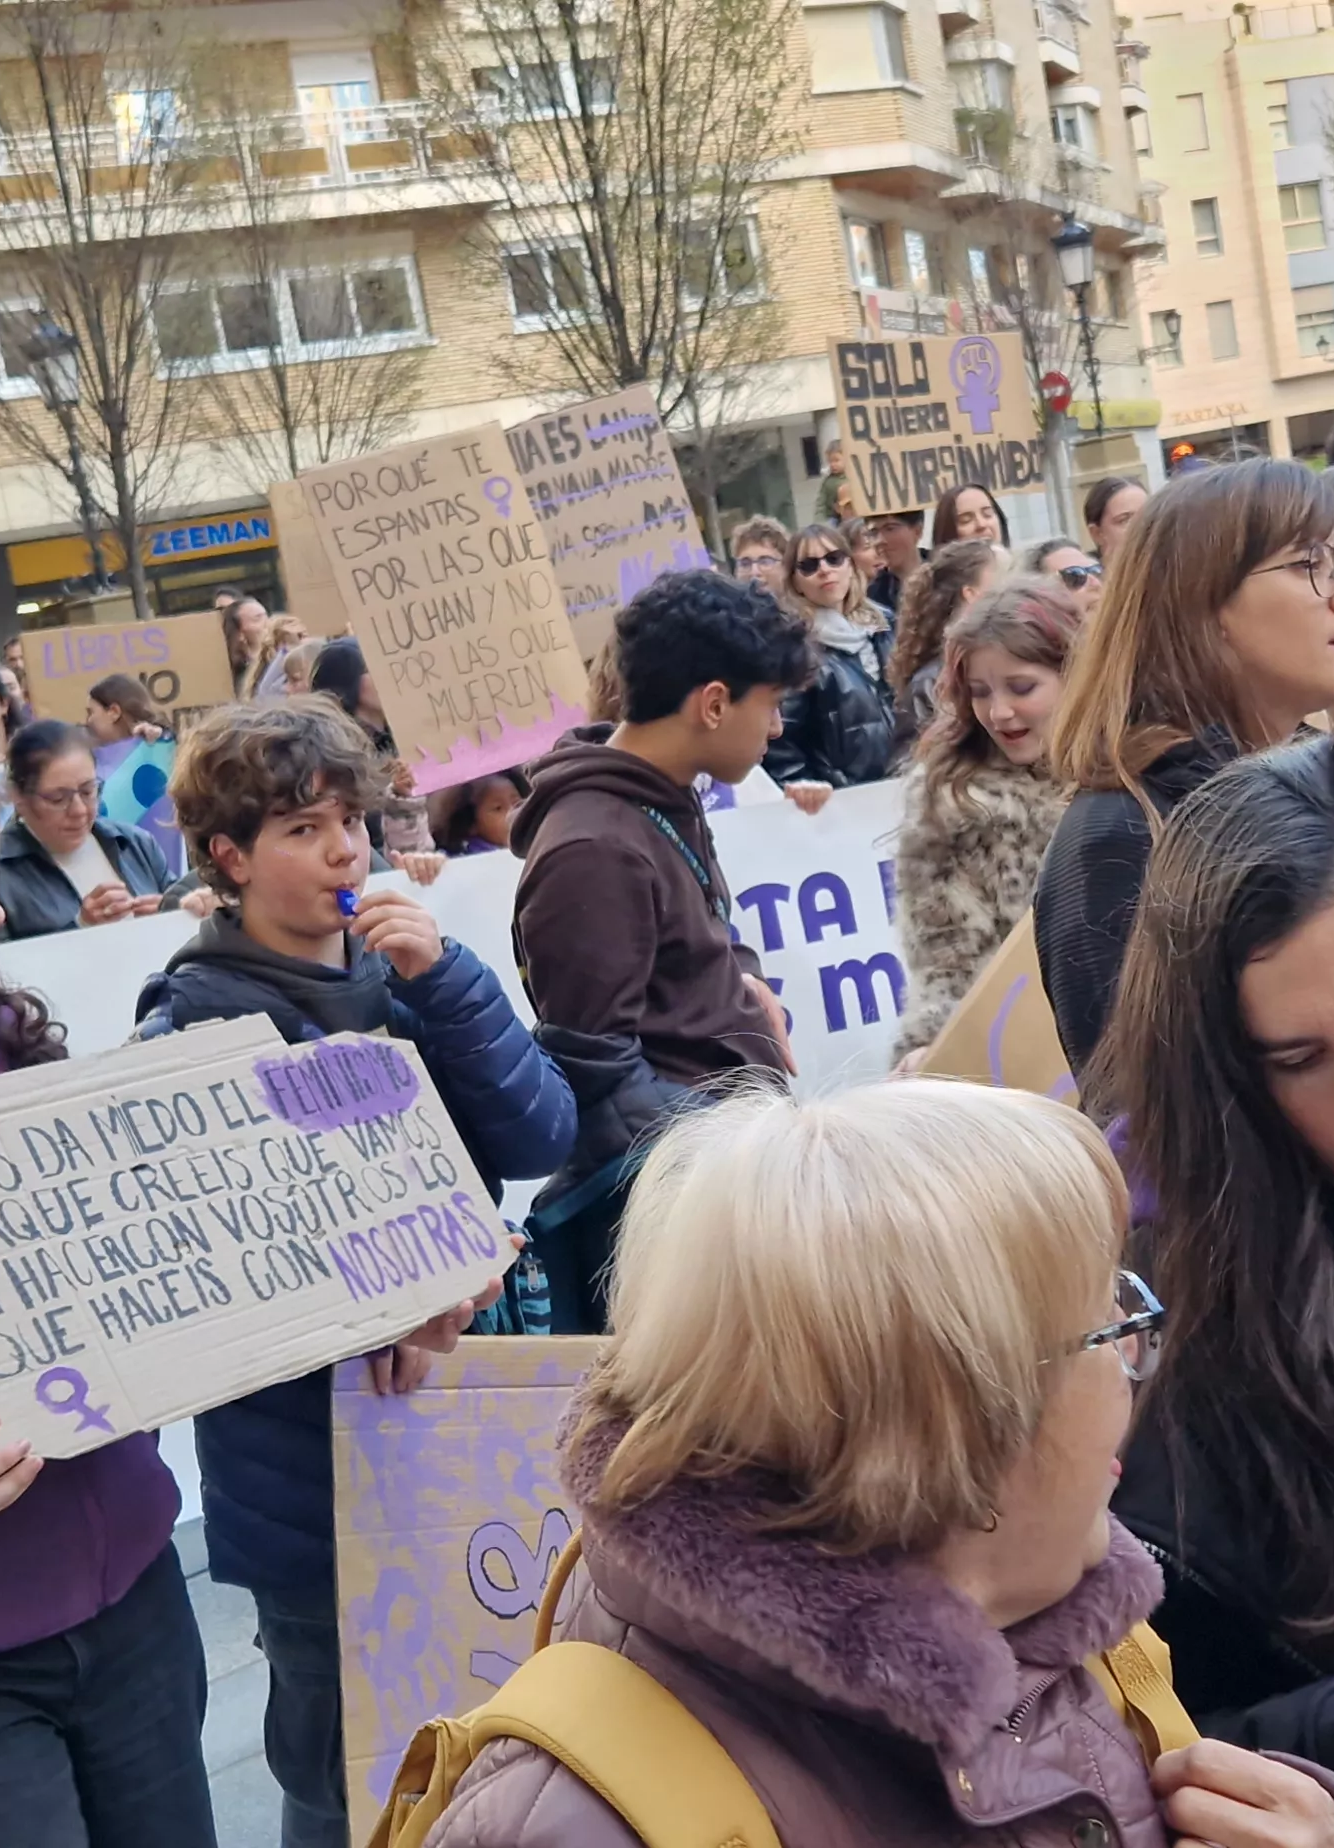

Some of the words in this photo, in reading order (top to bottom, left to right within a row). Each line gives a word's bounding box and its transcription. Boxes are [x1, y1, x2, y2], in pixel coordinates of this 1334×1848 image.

[836, 342, 930, 401] SOLO
[542, 415, 582, 465] ES
[847, 399, 951, 448] QUIERO
[452, 442, 493, 479] TE
[149, 517, 271, 557] ZEEMAN
[331, 493, 481, 560] ESPANTAS
[351, 560, 420, 606] POR
[421, 535, 485, 585] LAS
[488, 522, 550, 569] QUE
[369, 587, 476, 657] LUCHAN
[476, 583, 497, 624] Y
[505, 570, 553, 621] NO
[41, 626, 171, 680] LIBRES
[138, 669, 181, 705] O
[389, 650, 442, 696] POR
[449, 635, 500, 675] LAS
[509, 619, 569, 659] QUE
[427, 660, 557, 731] MUEREN
[731, 871, 859, 953] TA
[19, 1117, 96, 1179] DA
[207, 1078, 272, 1130] EL
[262, 1043, 413, 1120] FEMINISMO
[109, 1147, 255, 1212] CREEIS
[259, 1131, 340, 1185] QUE
[337, 1104, 443, 1163] VAMOS
[207, 1160, 409, 1244] VOSOTROS
[410, 1151, 458, 1191] LO
[88, 1256, 233, 1343] HACEIS
[241, 1236, 333, 1301] CON
[326, 1190, 499, 1304] NOSOTRAS
